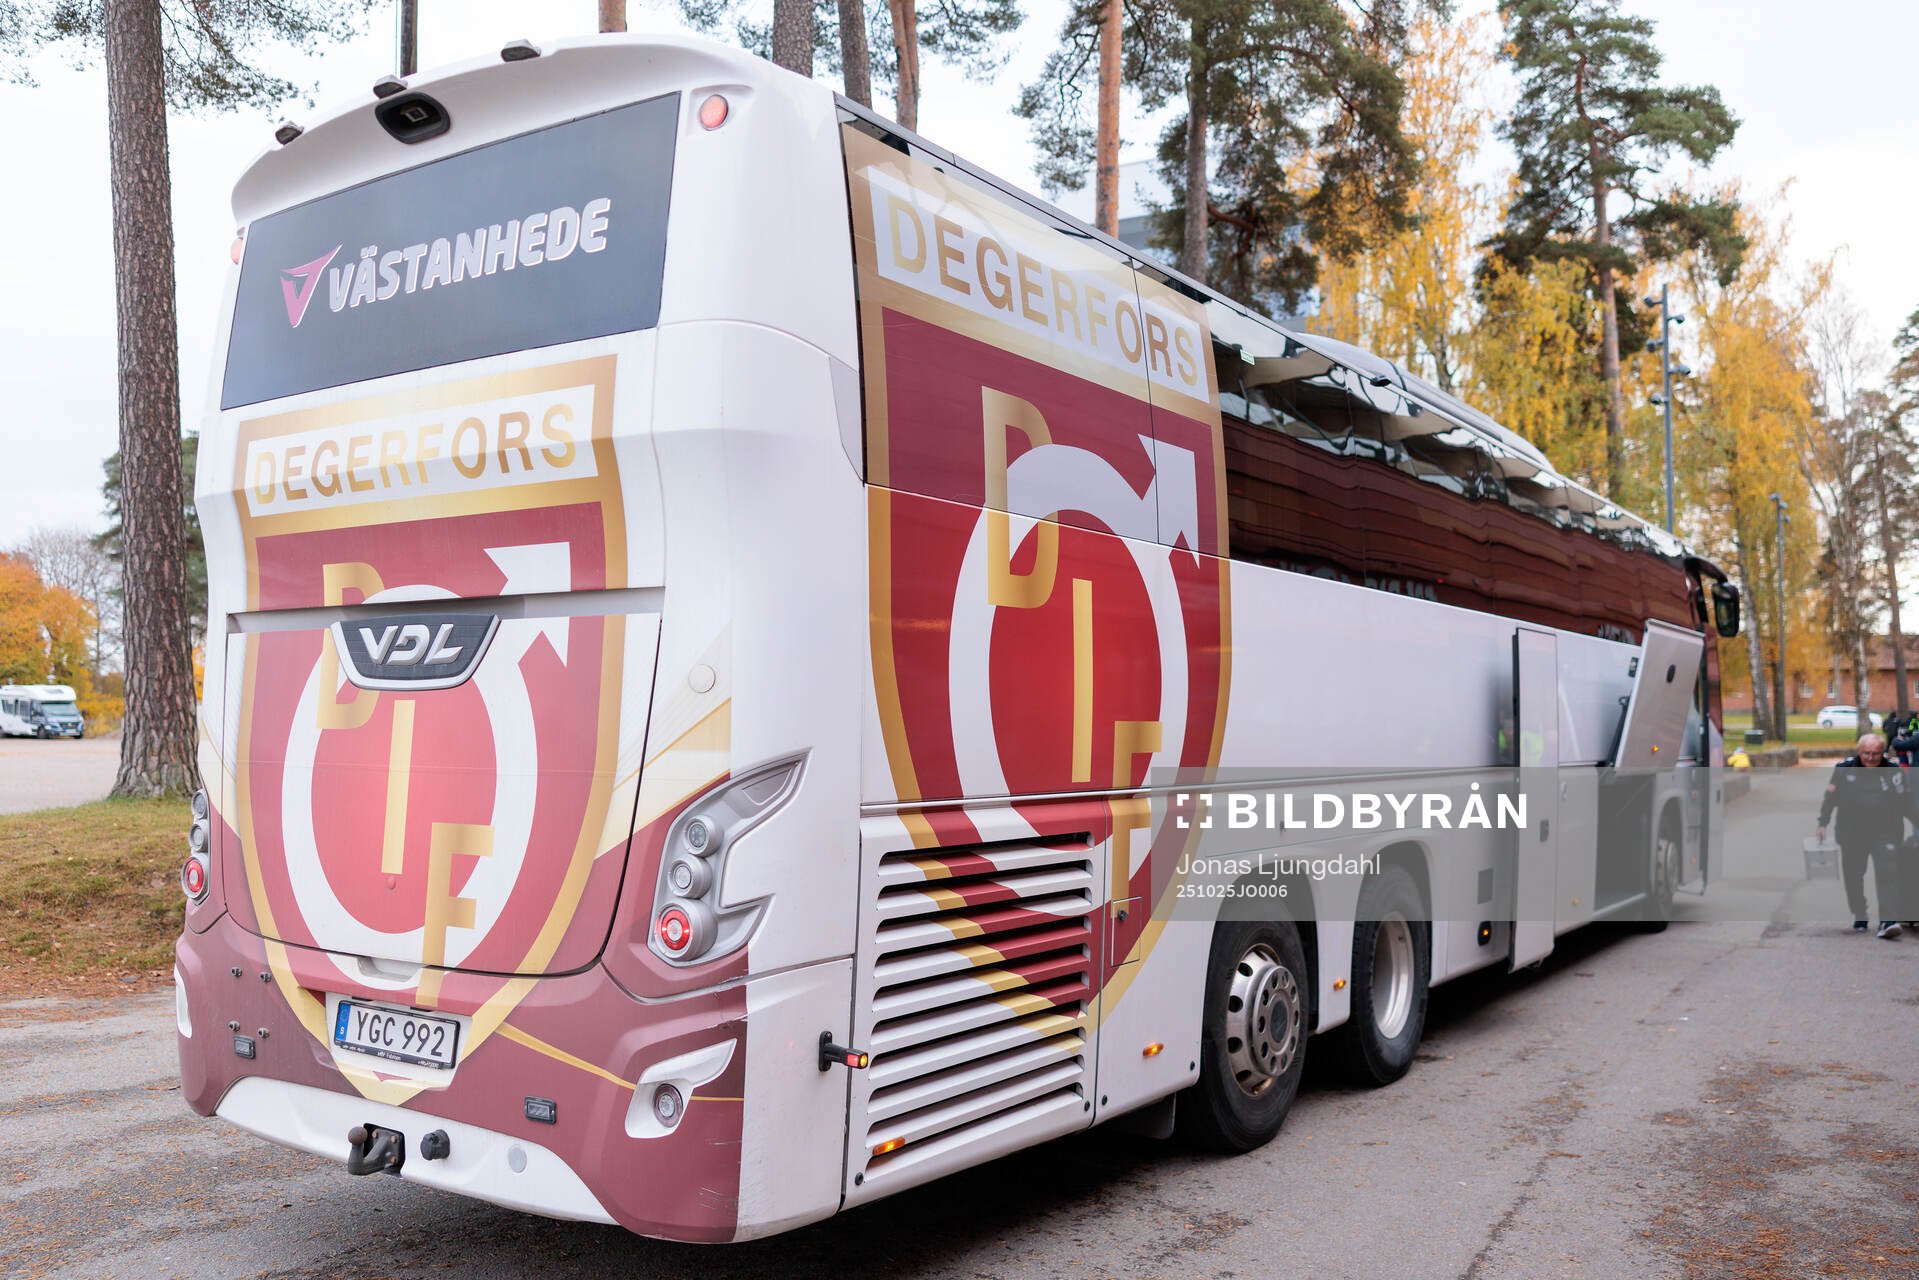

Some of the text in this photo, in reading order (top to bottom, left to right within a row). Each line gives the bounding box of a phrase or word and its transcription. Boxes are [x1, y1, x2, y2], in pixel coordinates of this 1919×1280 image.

[328, 197, 611, 312] VÄSTANHEDE
[887, 195, 1199, 386] DEGERFORS
[254, 403, 577, 505] DEGERFORS
[358, 623, 463, 665] VDL
[357, 1010, 445, 1057] YGC 992
